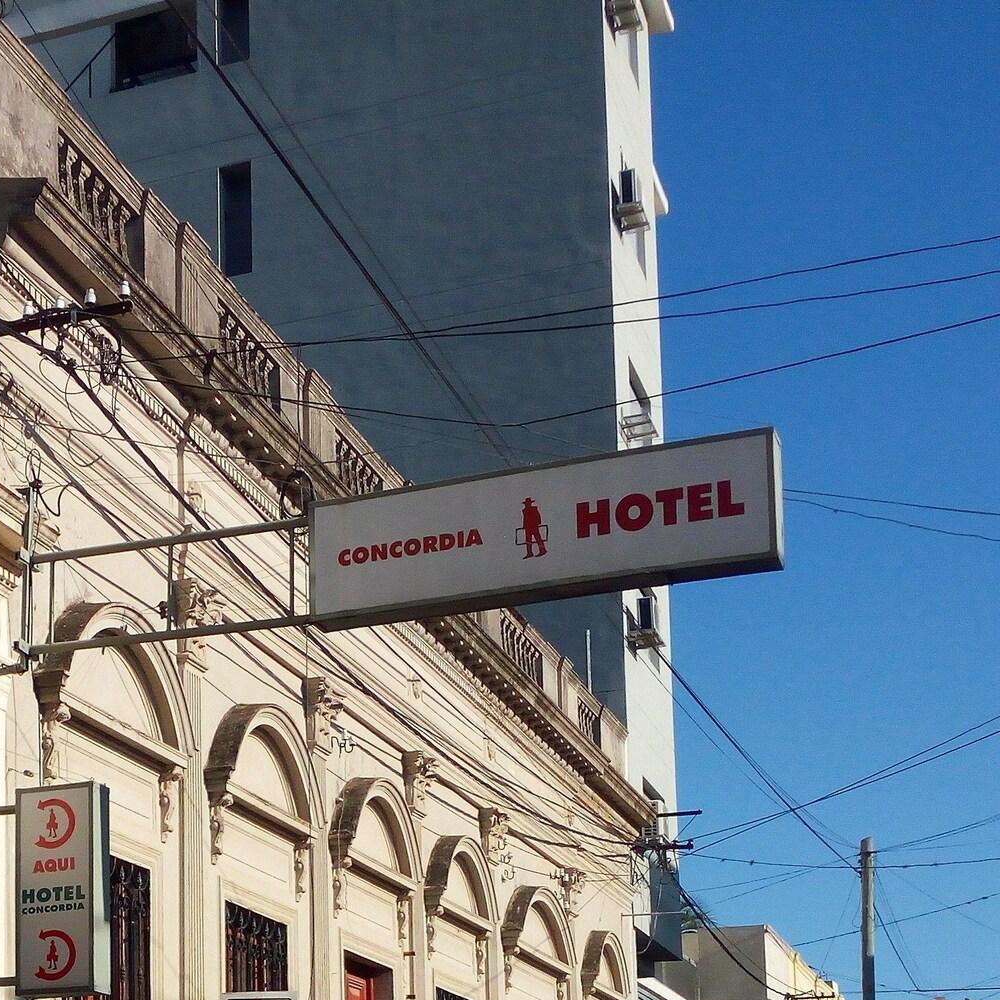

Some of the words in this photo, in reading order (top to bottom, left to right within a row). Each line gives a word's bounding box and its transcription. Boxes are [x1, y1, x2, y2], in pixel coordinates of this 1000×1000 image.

[338, 528, 483, 567] CONCORDIA
[576, 480, 745, 538] HOTEL
[33, 857, 75, 874] AQUI
[22, 885, 85, 904] HOTEL
[22, 903, 84, 915] CONCORDIA
